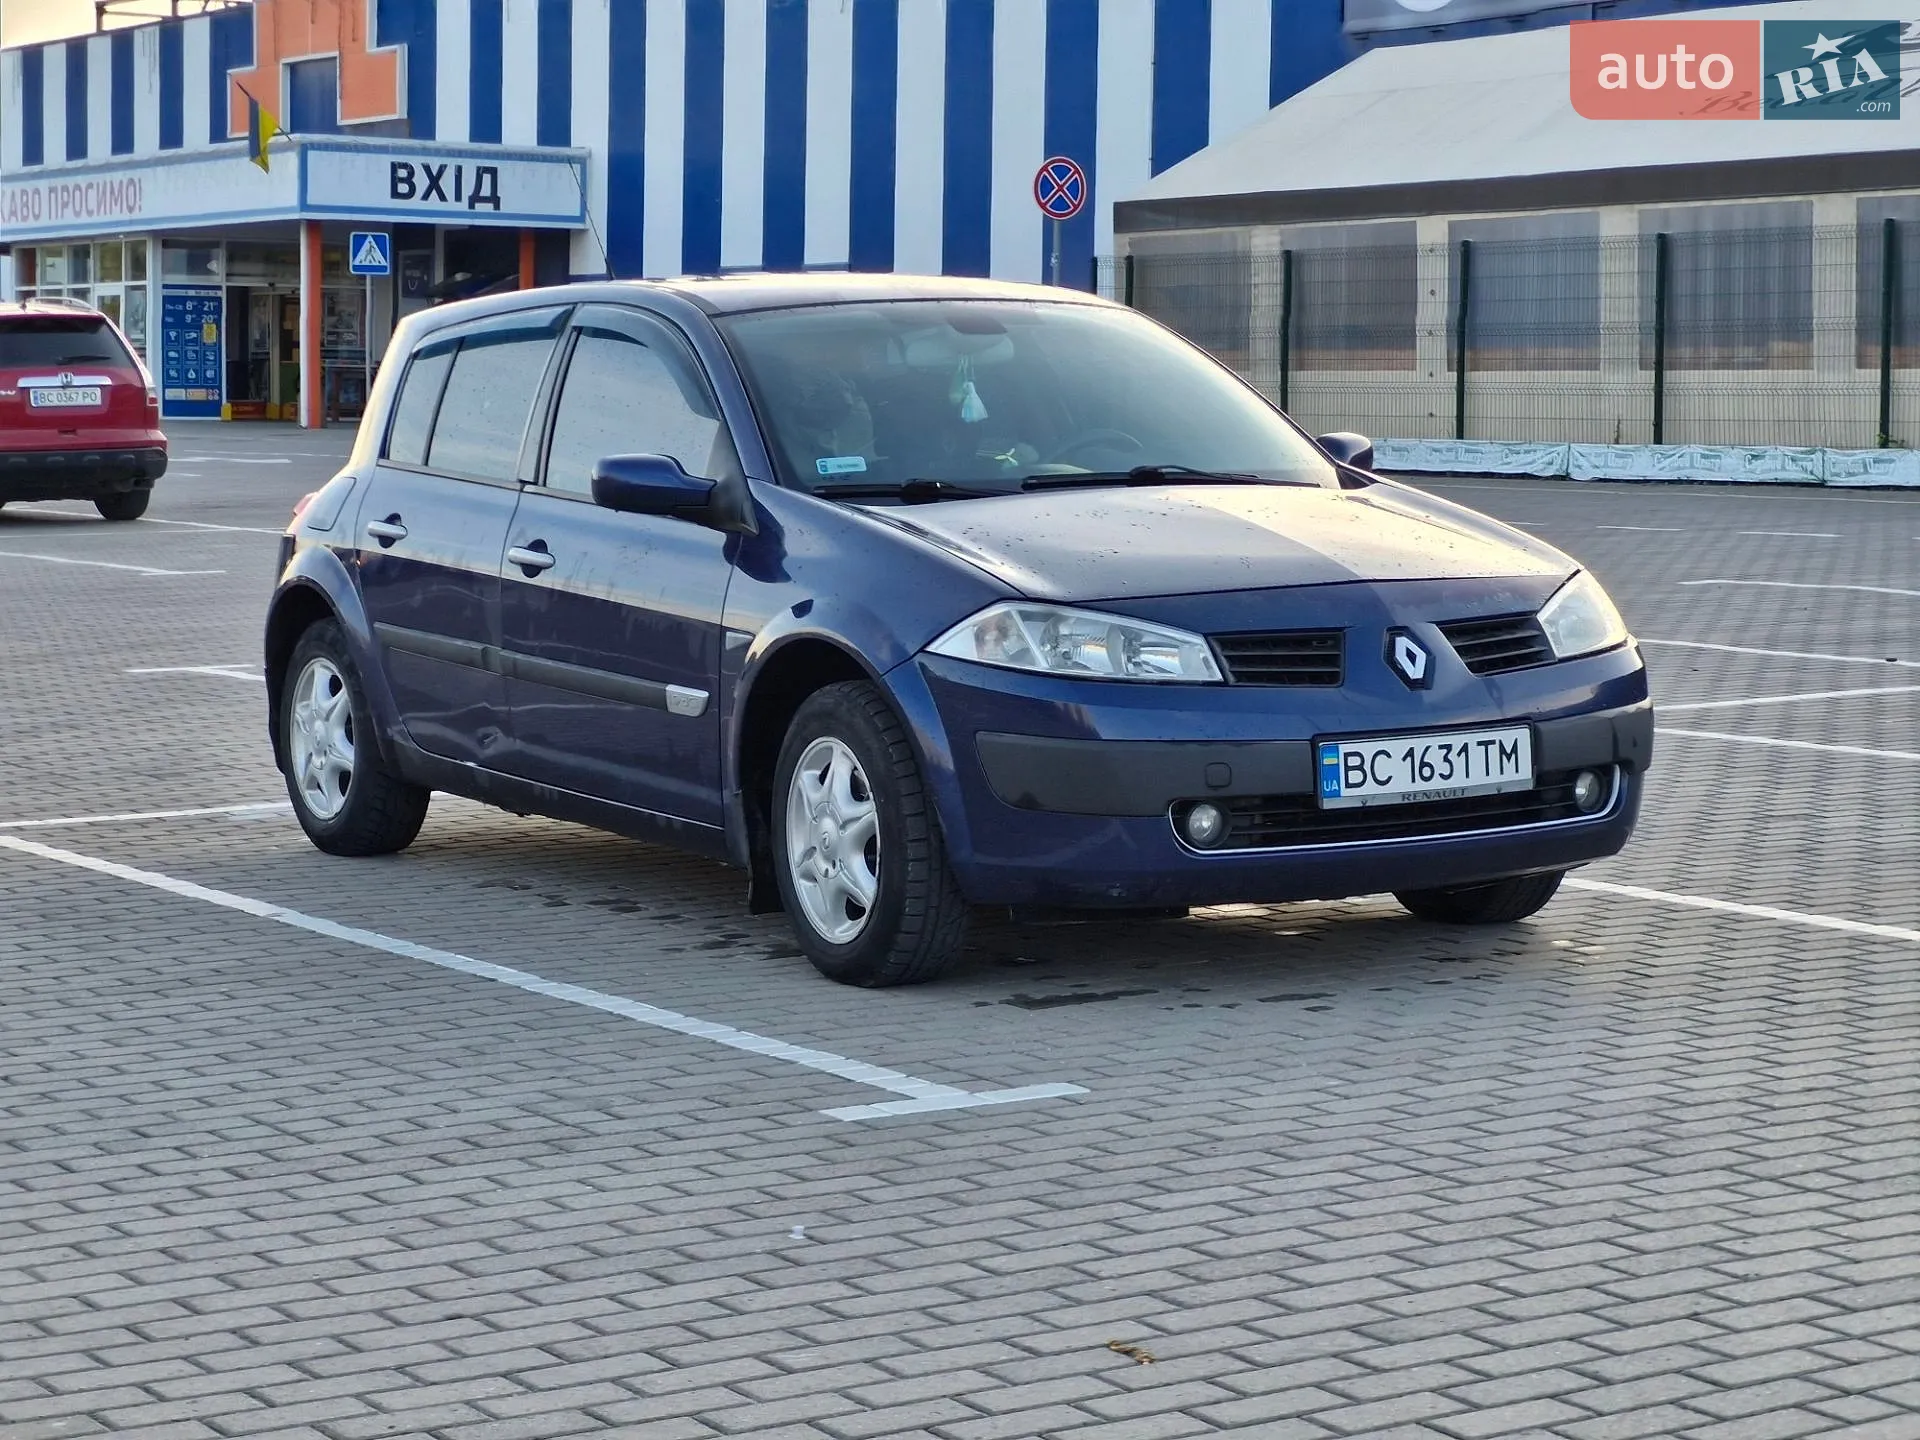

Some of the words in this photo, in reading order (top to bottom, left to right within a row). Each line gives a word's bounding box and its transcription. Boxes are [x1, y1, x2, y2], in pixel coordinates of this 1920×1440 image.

[48, 177, 142, 221] ПРОСИМО!
[390, 161, 501, 211] ВХІД
[1343, 749, 1393, 789] BC
[1401, 742, 1470, 783] 1631
[1476, 737, 1519, 776] TM
[1323, 779, 1339, 792] UA
[1401, 788, 1466, 802] RENAULT
